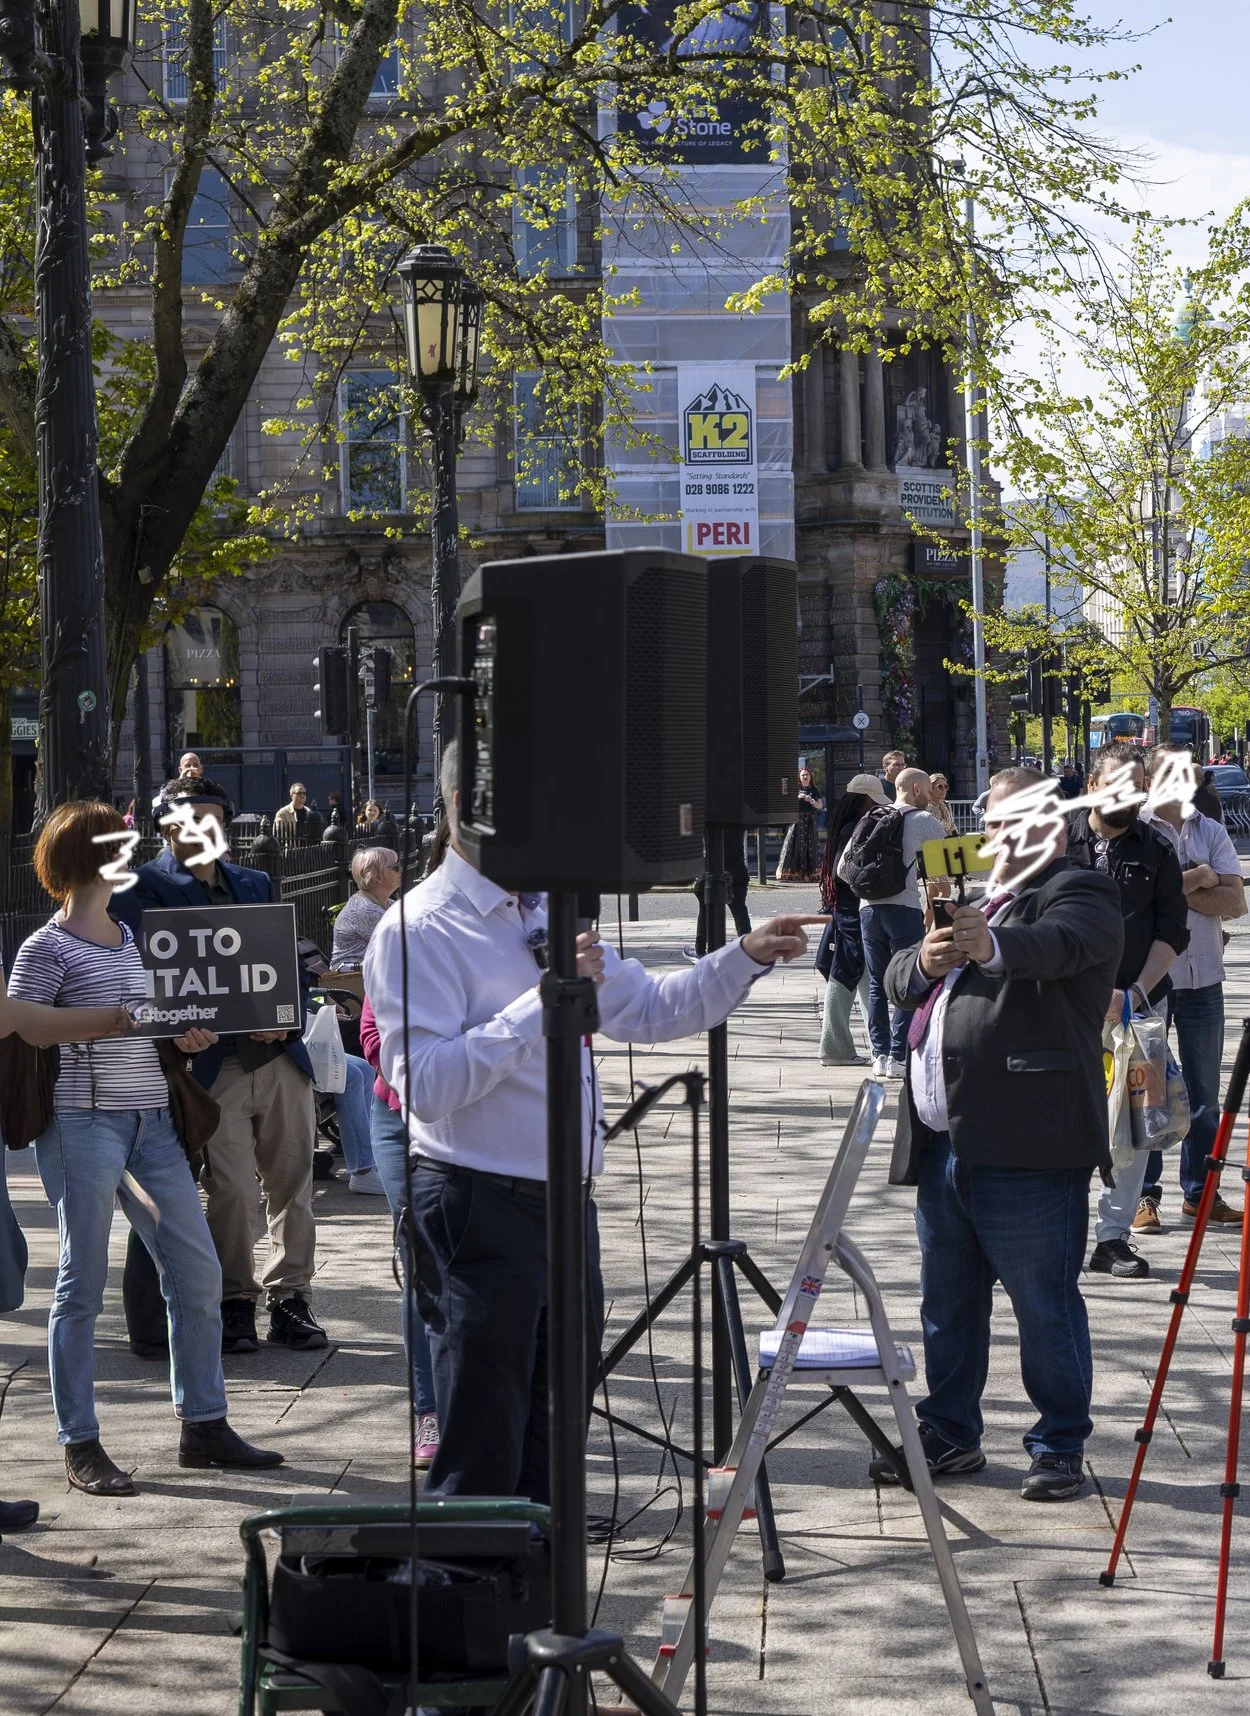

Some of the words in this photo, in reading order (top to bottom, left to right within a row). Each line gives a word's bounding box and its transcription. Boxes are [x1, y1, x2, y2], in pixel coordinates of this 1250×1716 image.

[676, 117, 732, 135] Stone
[689, 414, 749, 449] K2
[692, 450, 746, 458] SCAFFOLDING
[685, 484, 703, 495] 028
[705, 483, 730, 495] 9086
[733, 483, 755, 495] 1222
[900, 493, 951, 507] PROVIDENT
[697, 522, 750, 546] PERI
[926, 548, 958, 562] PIZZA
[186, 649, 221, 659] PIZZA
[11, 725, 37, 736] GGIES
[144, 929, 178, 960] O
[189, 927, 242, 958] TO
[146, 966, 230, 998] ITAL
[240, 963, 278, 993] ID
